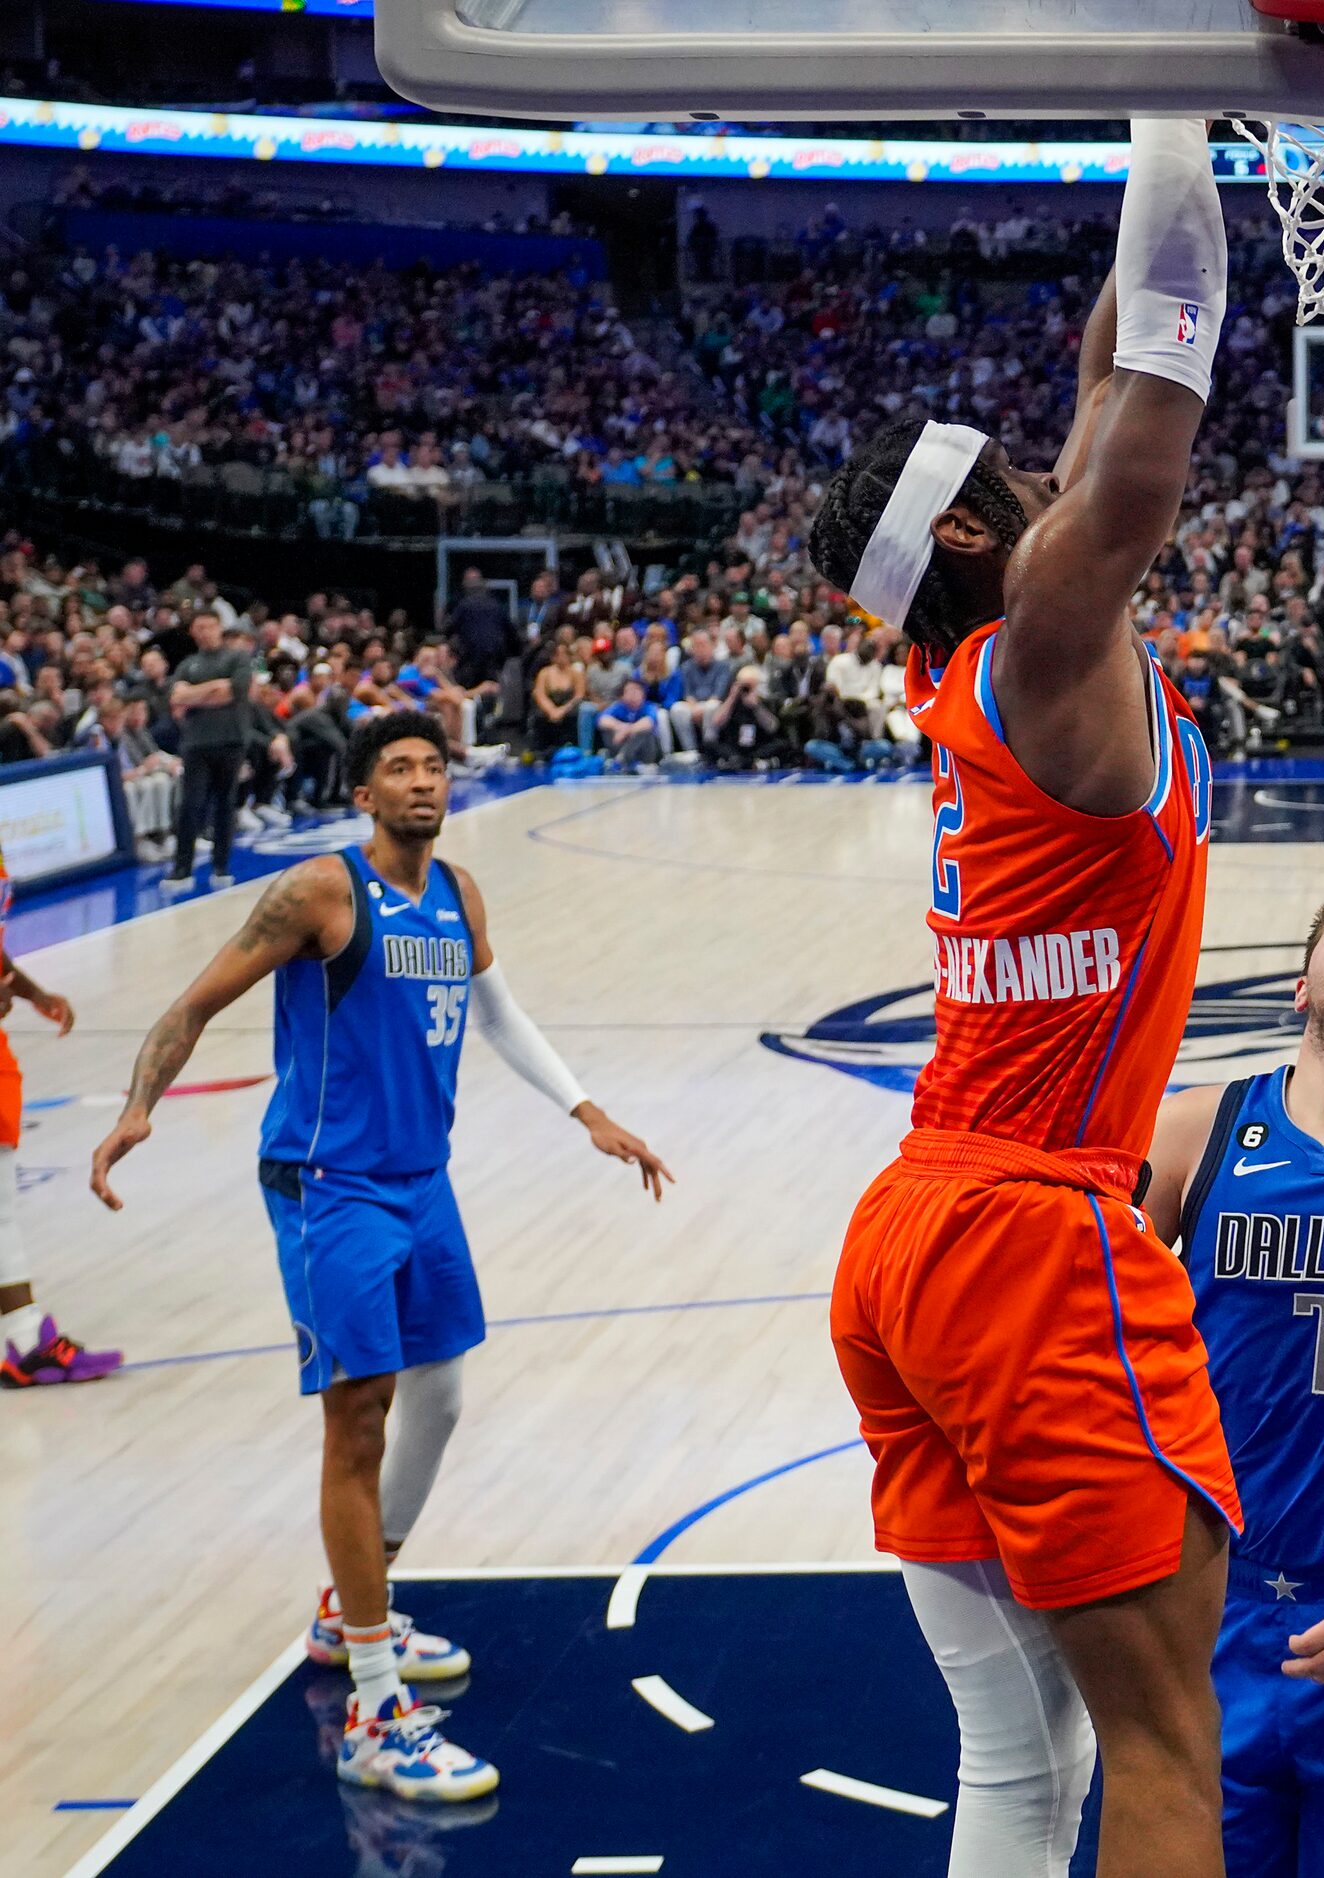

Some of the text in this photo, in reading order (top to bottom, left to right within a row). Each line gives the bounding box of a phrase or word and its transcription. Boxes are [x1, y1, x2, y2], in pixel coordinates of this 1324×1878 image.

[383, 934, 468, 980] DALLAS
[426, 985, 467, 1046] 35
[1243, 1126, 1264, 1147] 6
